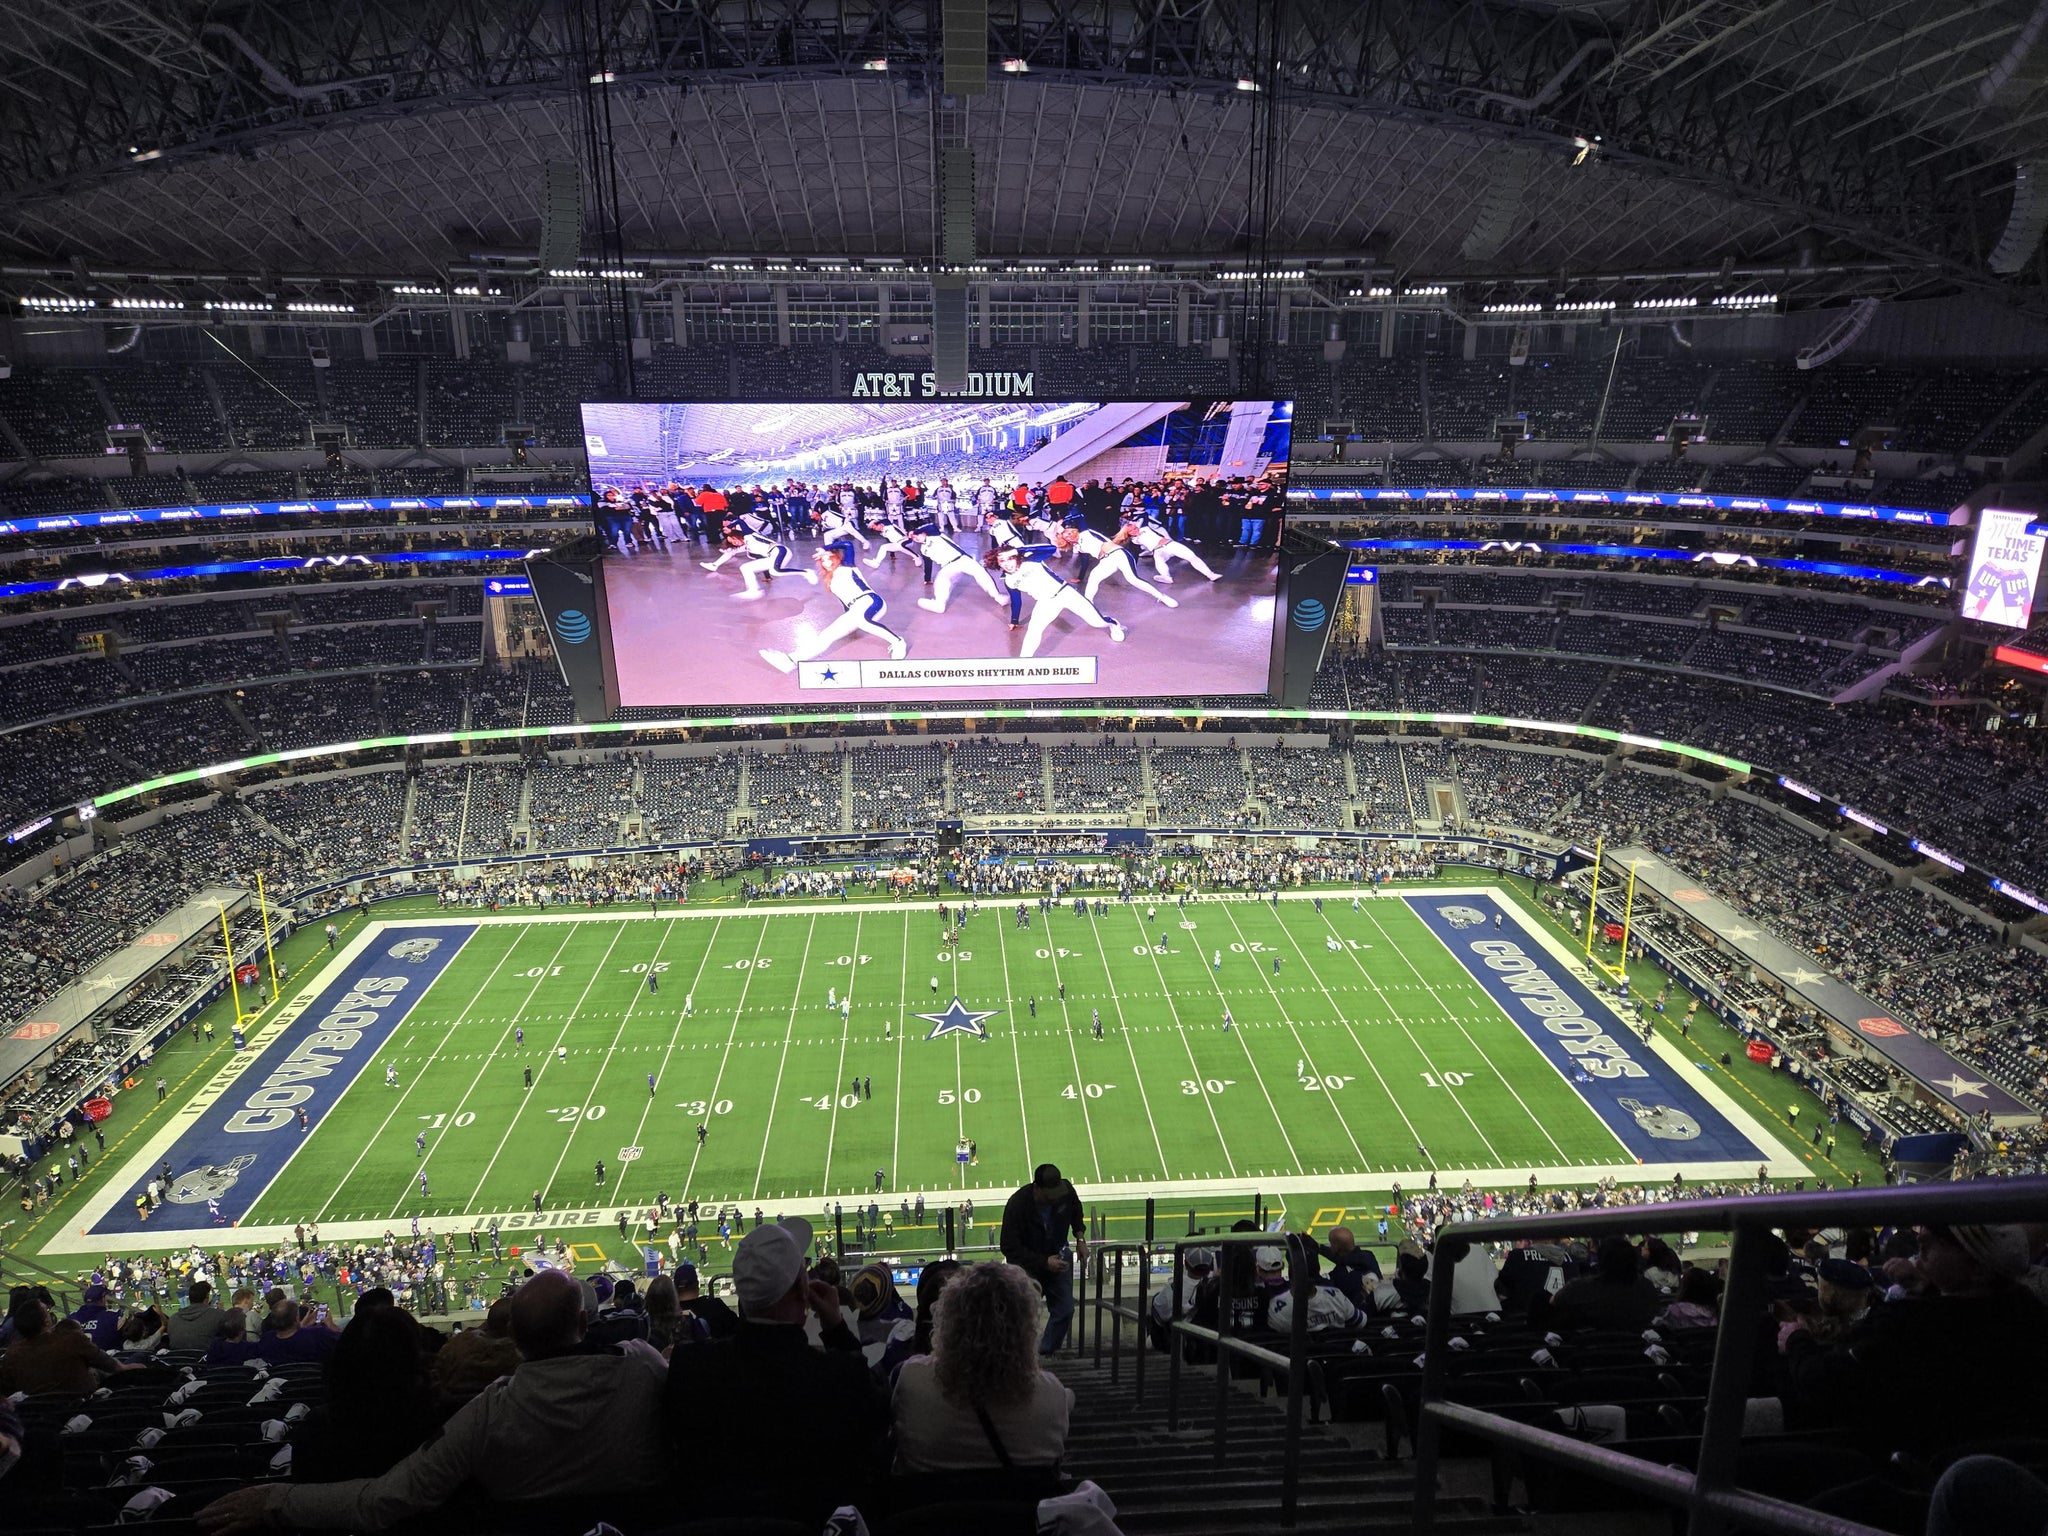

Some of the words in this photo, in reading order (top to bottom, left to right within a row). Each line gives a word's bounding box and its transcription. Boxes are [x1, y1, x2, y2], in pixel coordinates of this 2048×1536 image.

[852, 373, 914, 397] AT&T
[921, 373, 1034, 397] SDIUM
[100, 515, 131, 524] American
[160, 510, 192, 518] American
[1840, 506, 1870, 517] American
[1895, 510, 1924, 522] American
[38, 519, 70, 528] American
[2005, 537, 2038, 553] TIME,
[1988, 546, 2028, 562] TEXAS
[2006, 578, 2028, 594] Lite
[878, 670, 922, 680] DALLAS
[924, 668, 975, 678] COWBOYS
[976, 668, 1024, 678] RHYTHM
[1026, 668, 1050, 677] AND
[1052, 667, 1080, 676] BLUE
[1917, 841, 1966, 872] Blockchain.com
[1470, 940, 1650, 1079] COWBOYS
[182, 1096, 208, 1114] IT
[200, 1055, 252, 1097] TAKES
[253, 1028, 282, 1050] ALL
[274, 1010, 297, 1028] OF
[296, 994, 315, 1008] US
[224, 976, 410, 1134] COWBOYS
[1180, 1079, 1225, 1094] 30
[1303, 1075, 1345, 1090] 20
[1420, 1071, 1465, 1088] 10
[937, 1088, 982, 1104] 50
[1060, 1083, 1104, 1100] 40
[686, 1099, 735, 1116] 30
[814, 1094, 859, 1110] 40
[427, 1111, 477, 1130] 10
[556, 1105, 606, 1123] 20
[474, 1211, 601, 1230] INSPIRE
